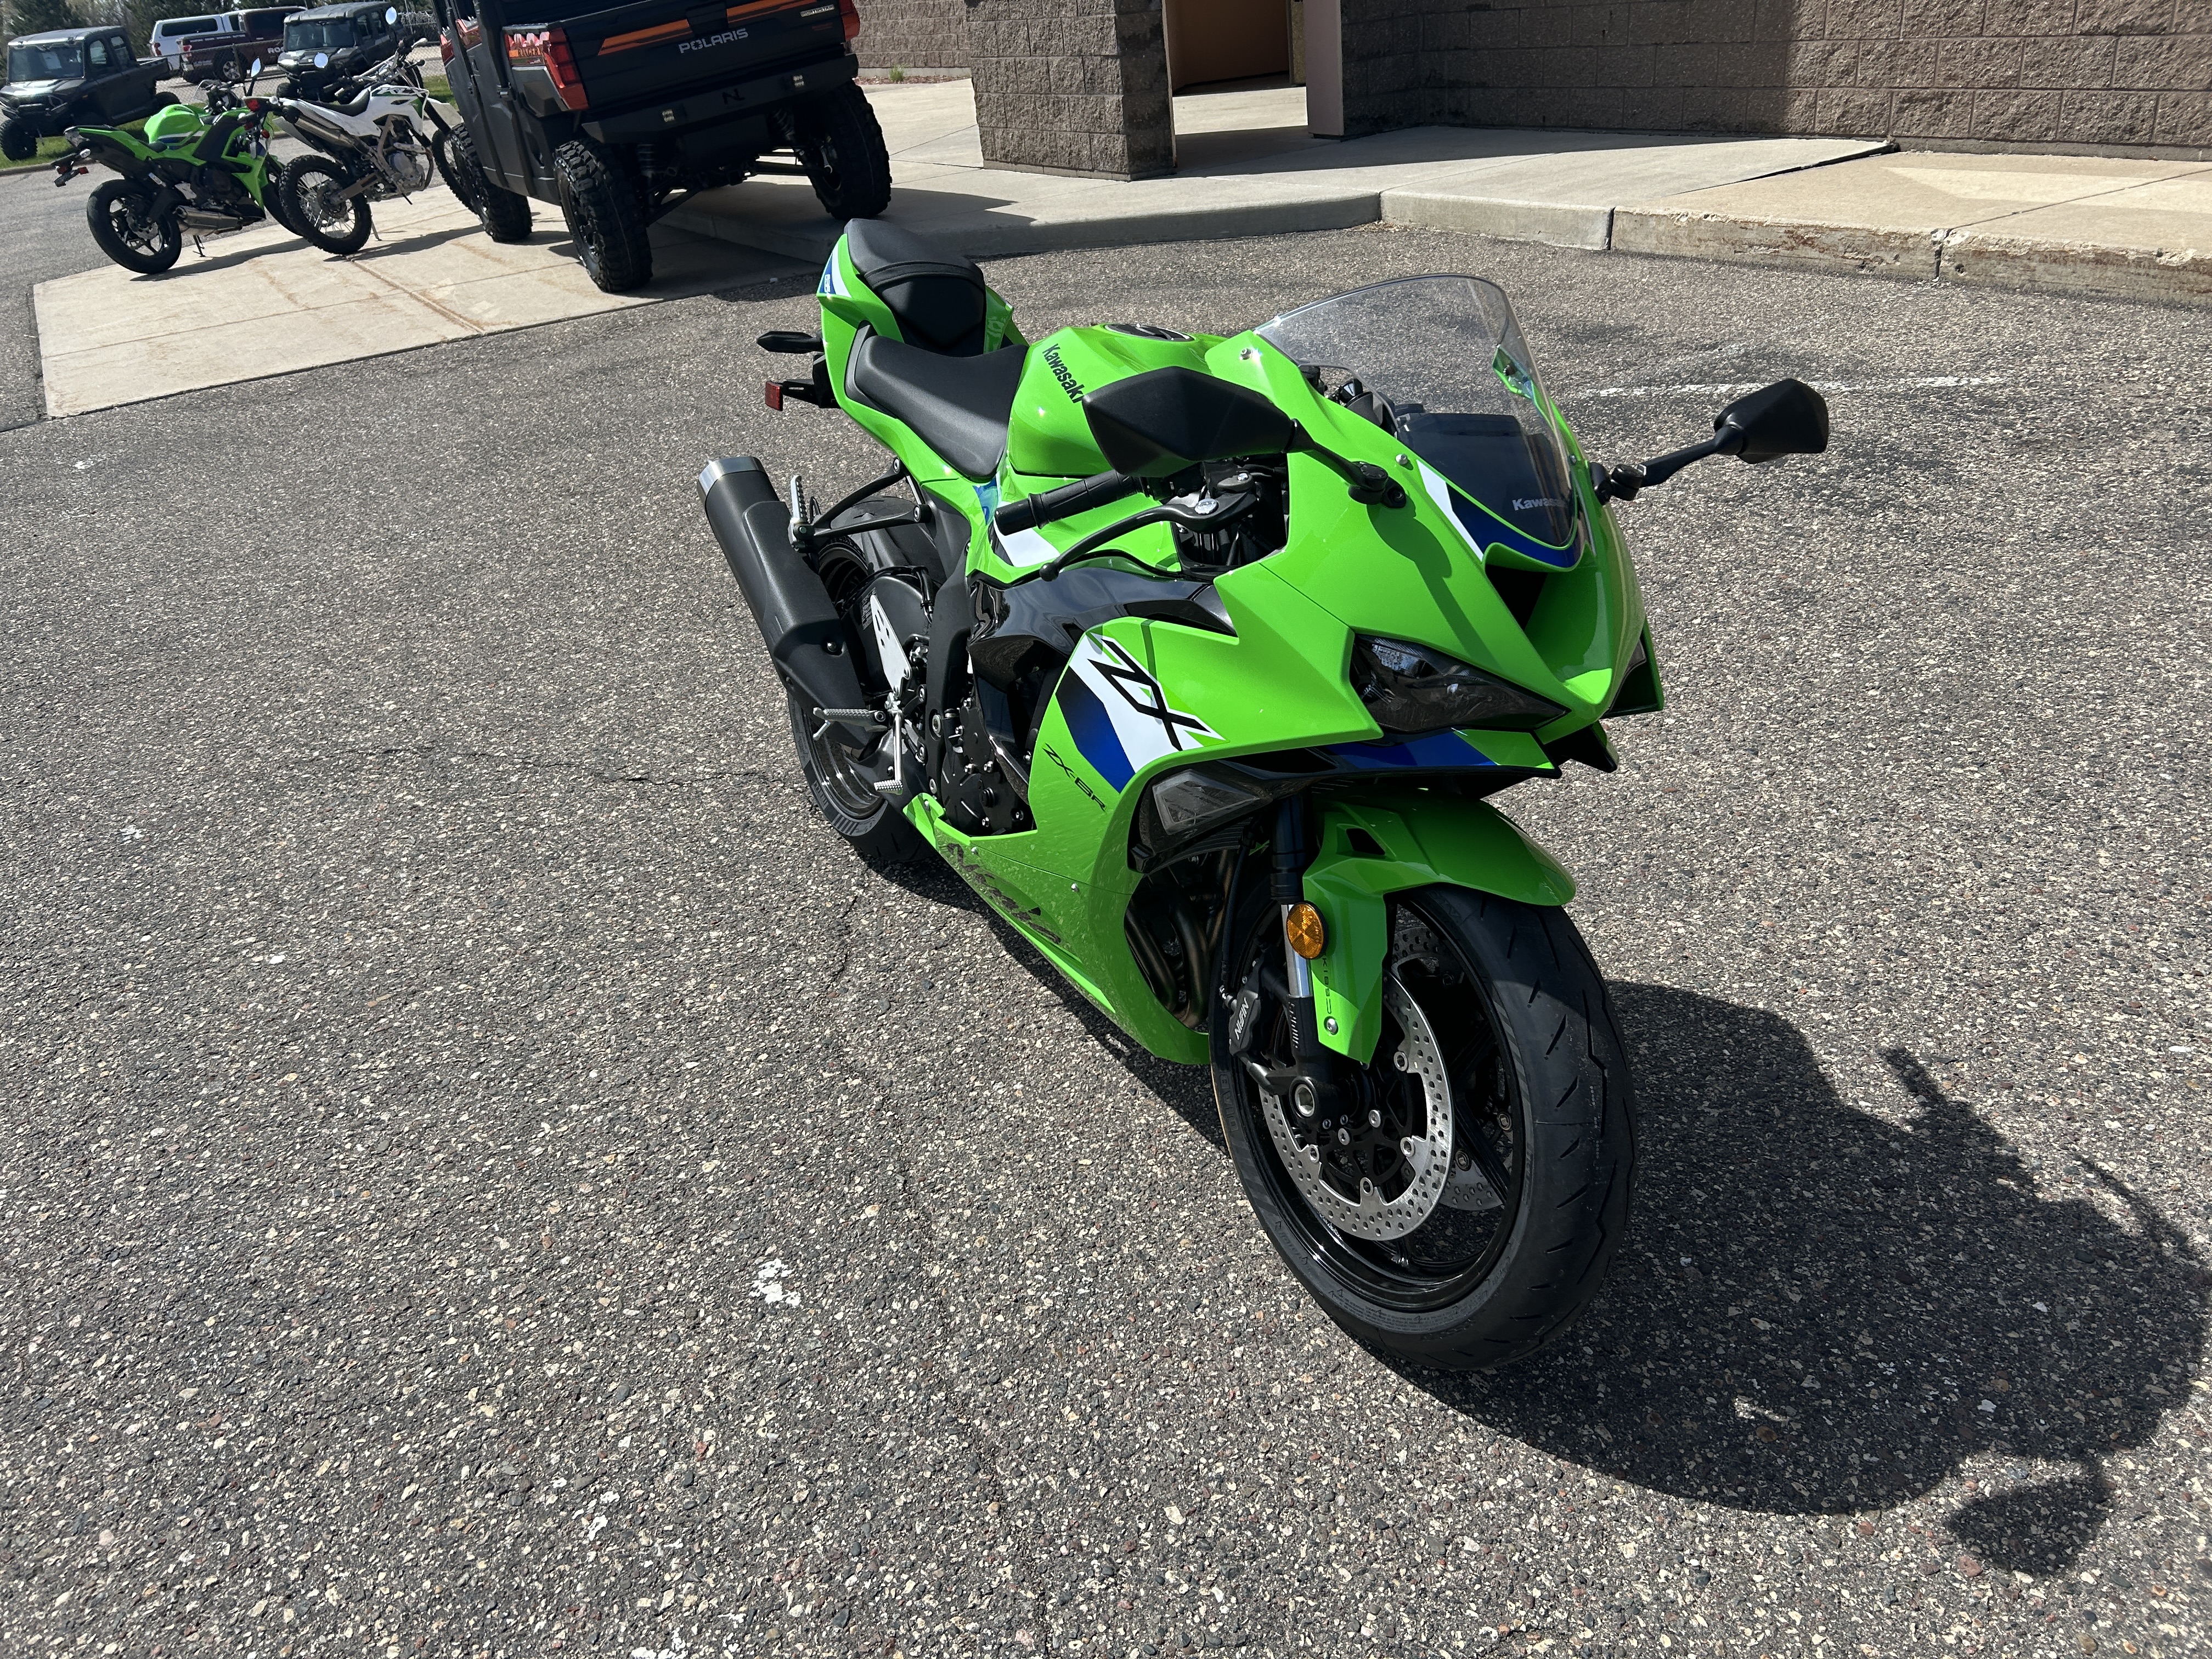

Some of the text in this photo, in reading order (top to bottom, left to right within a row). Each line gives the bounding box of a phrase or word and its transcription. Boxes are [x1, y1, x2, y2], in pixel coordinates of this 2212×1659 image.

[678, 28, 749, 54] POLARIS
[1042, 343, 1085, 403] Kawasaki
[1087, 638, 1211, 751] ZX
[1042, 742, 1107, 814] ZX-6R
[1234, 997, 1249, 1040] NISSIN
